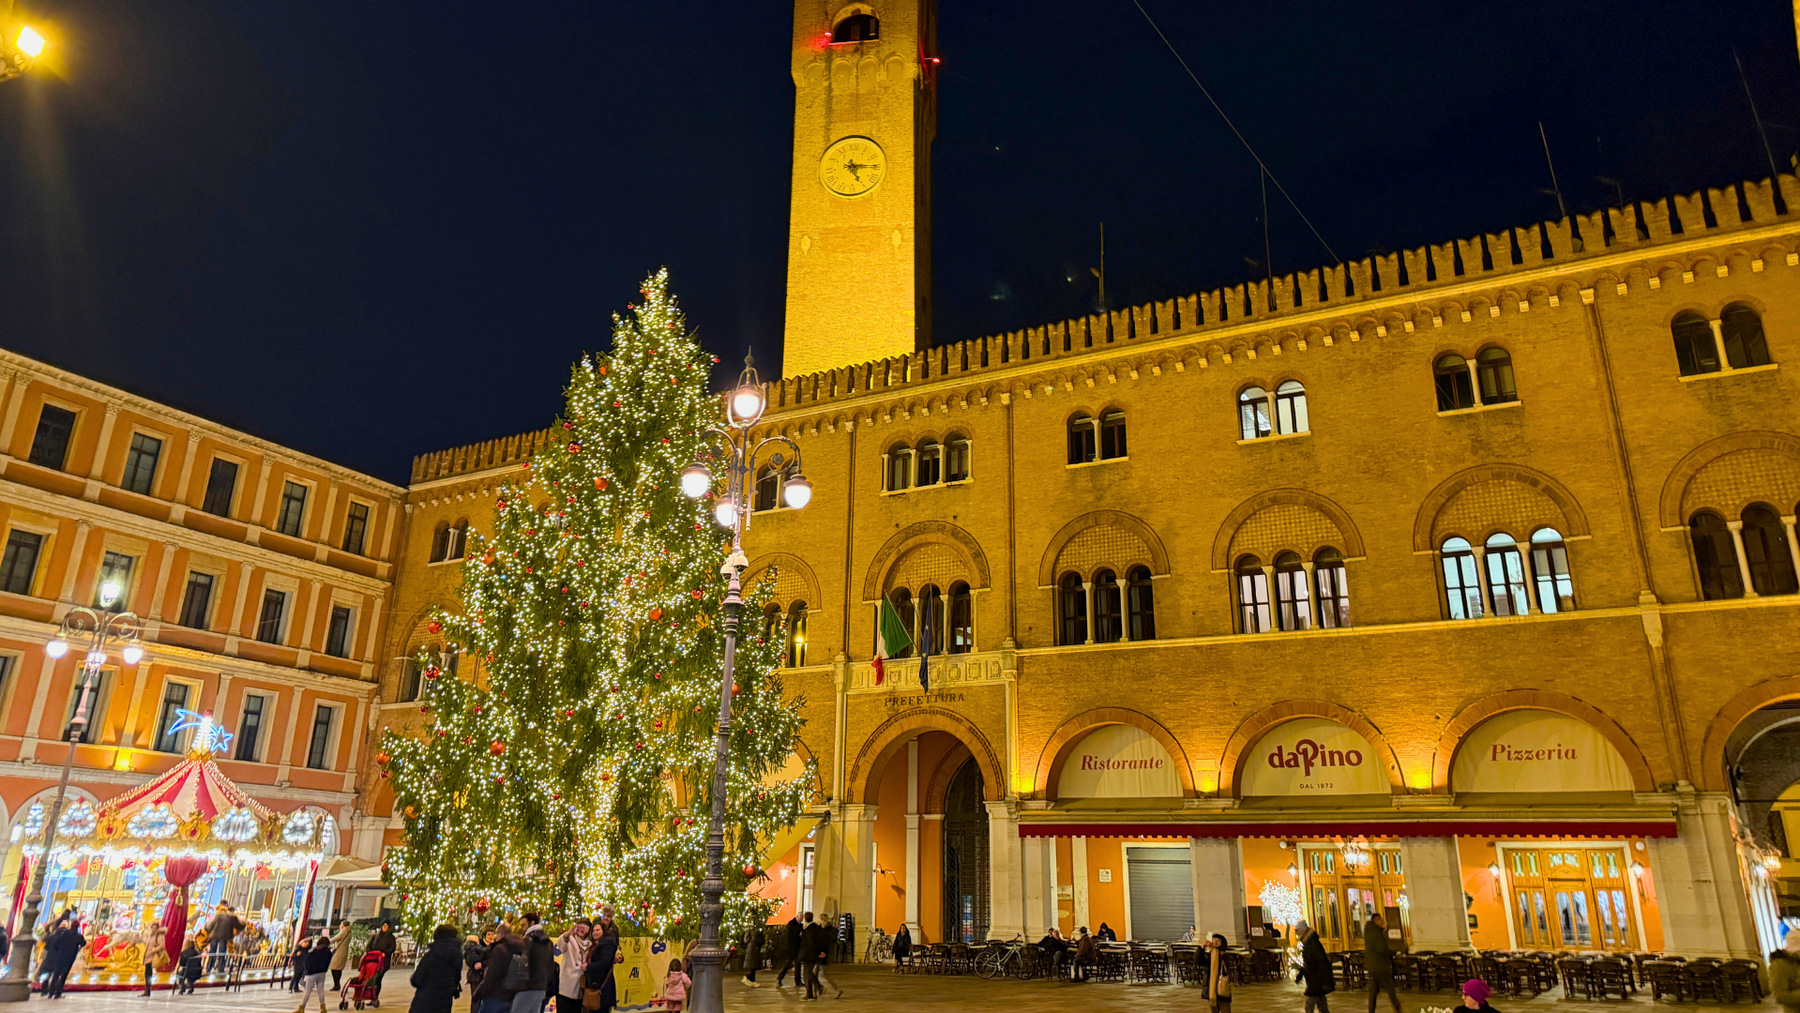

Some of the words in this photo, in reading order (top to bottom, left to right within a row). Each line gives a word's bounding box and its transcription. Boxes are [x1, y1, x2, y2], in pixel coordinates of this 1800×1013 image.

[884, 692, 965, 707] PREFETTURA
[1490, 743, 1578, 761] Pizzeria
[1080, 755, 1164, 770] Ristorante
